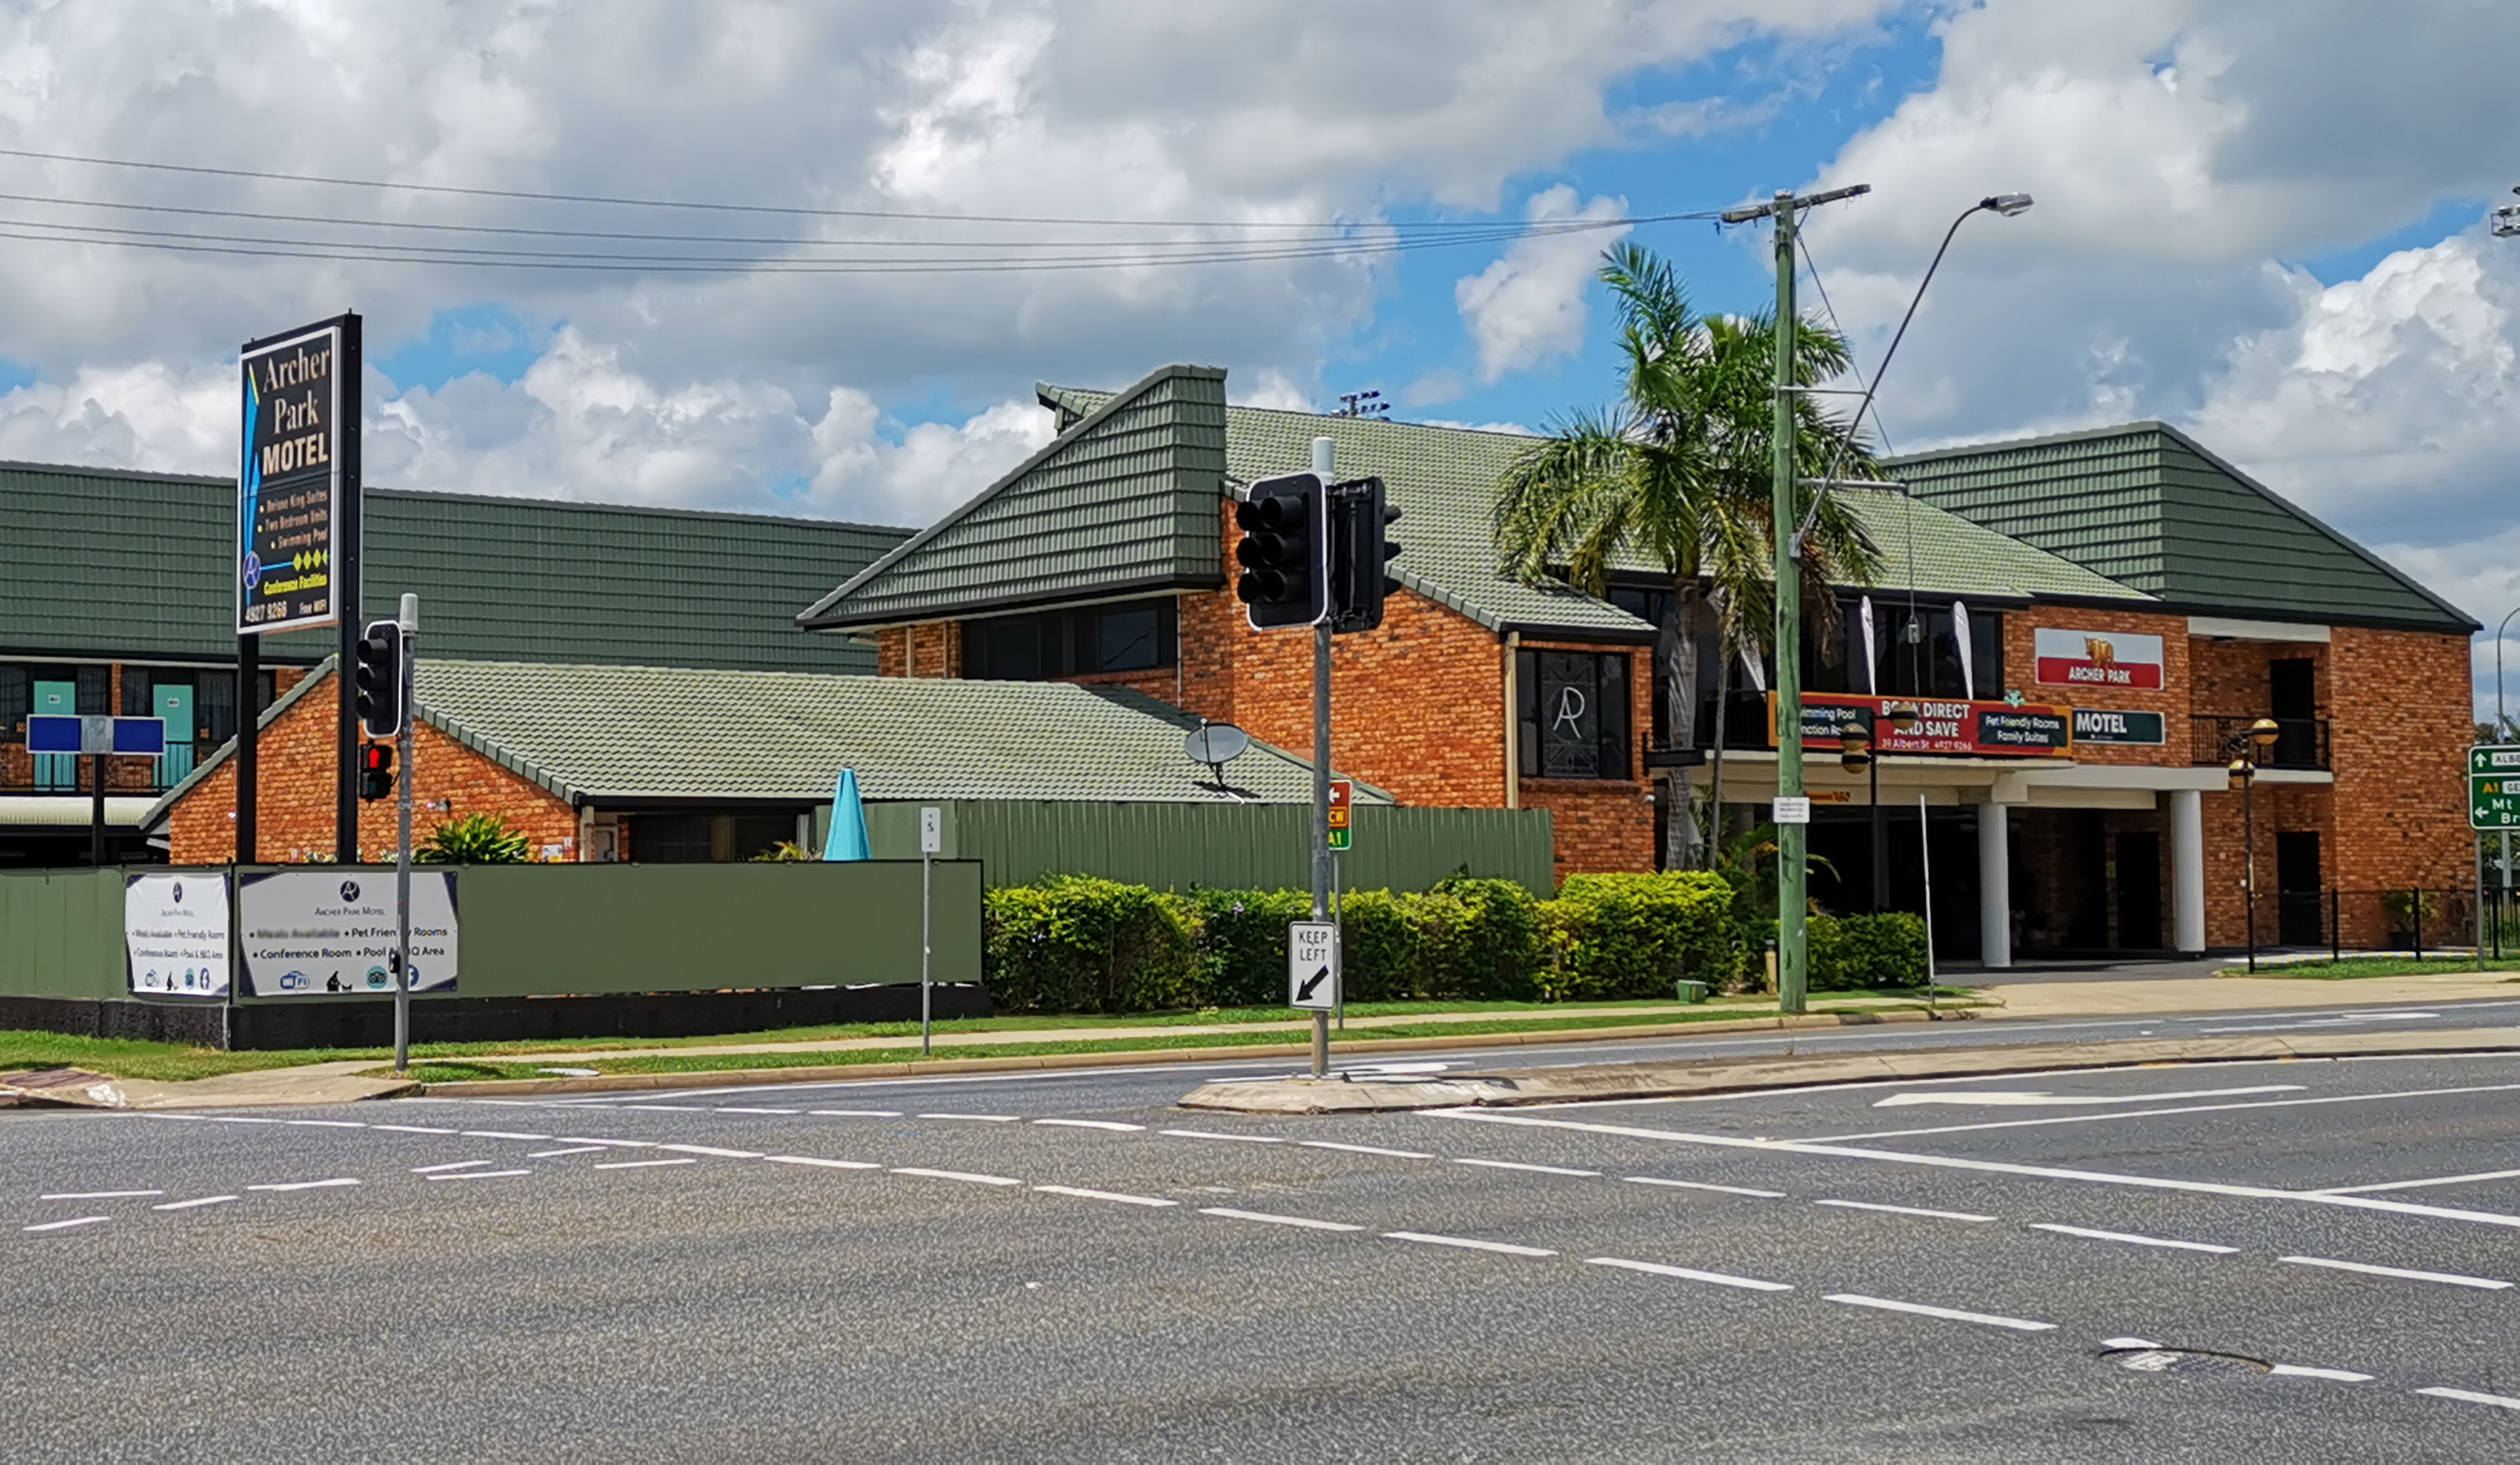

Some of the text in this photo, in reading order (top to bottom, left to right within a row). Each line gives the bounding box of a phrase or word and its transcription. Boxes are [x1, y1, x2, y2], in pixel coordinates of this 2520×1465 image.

[262, 347, 330, 393] Archer
[274, 390, 319, 435] Park
[262, 432, 328, 476] MOTEL
[278, 527, 328, 549] Swimming Pool
[2068, 666, 2132, 684] ARCHER PARK
[1836, 708, 1856, 719] Pool
[1923, 701, 1971, 719] DIRECT
[1925, 721, 1959, 738] SAVE
[1985, 716, 1999, 727] Pet
[2033, 717, 2060, 729] Rooms
[2076, 712, 2127, 733] MOTEL
[1997, 730, 2024, 743] Family
[2482, 781, 2499, 794] A1
[2492, 798, 2512, 810] Mt
[352, 927, 369, 937] Pet
[414, 927, 447, 937] Rooms
[1299, 931, 1328, 944] KEEP
[260, 948, 319, 959] Conference
[322, 948, 352, 958] Room
[363, 947, 386, 957] Pool
[422, 947, 444, 956] Area
[1299, 948, 1326, 962] LEFT
